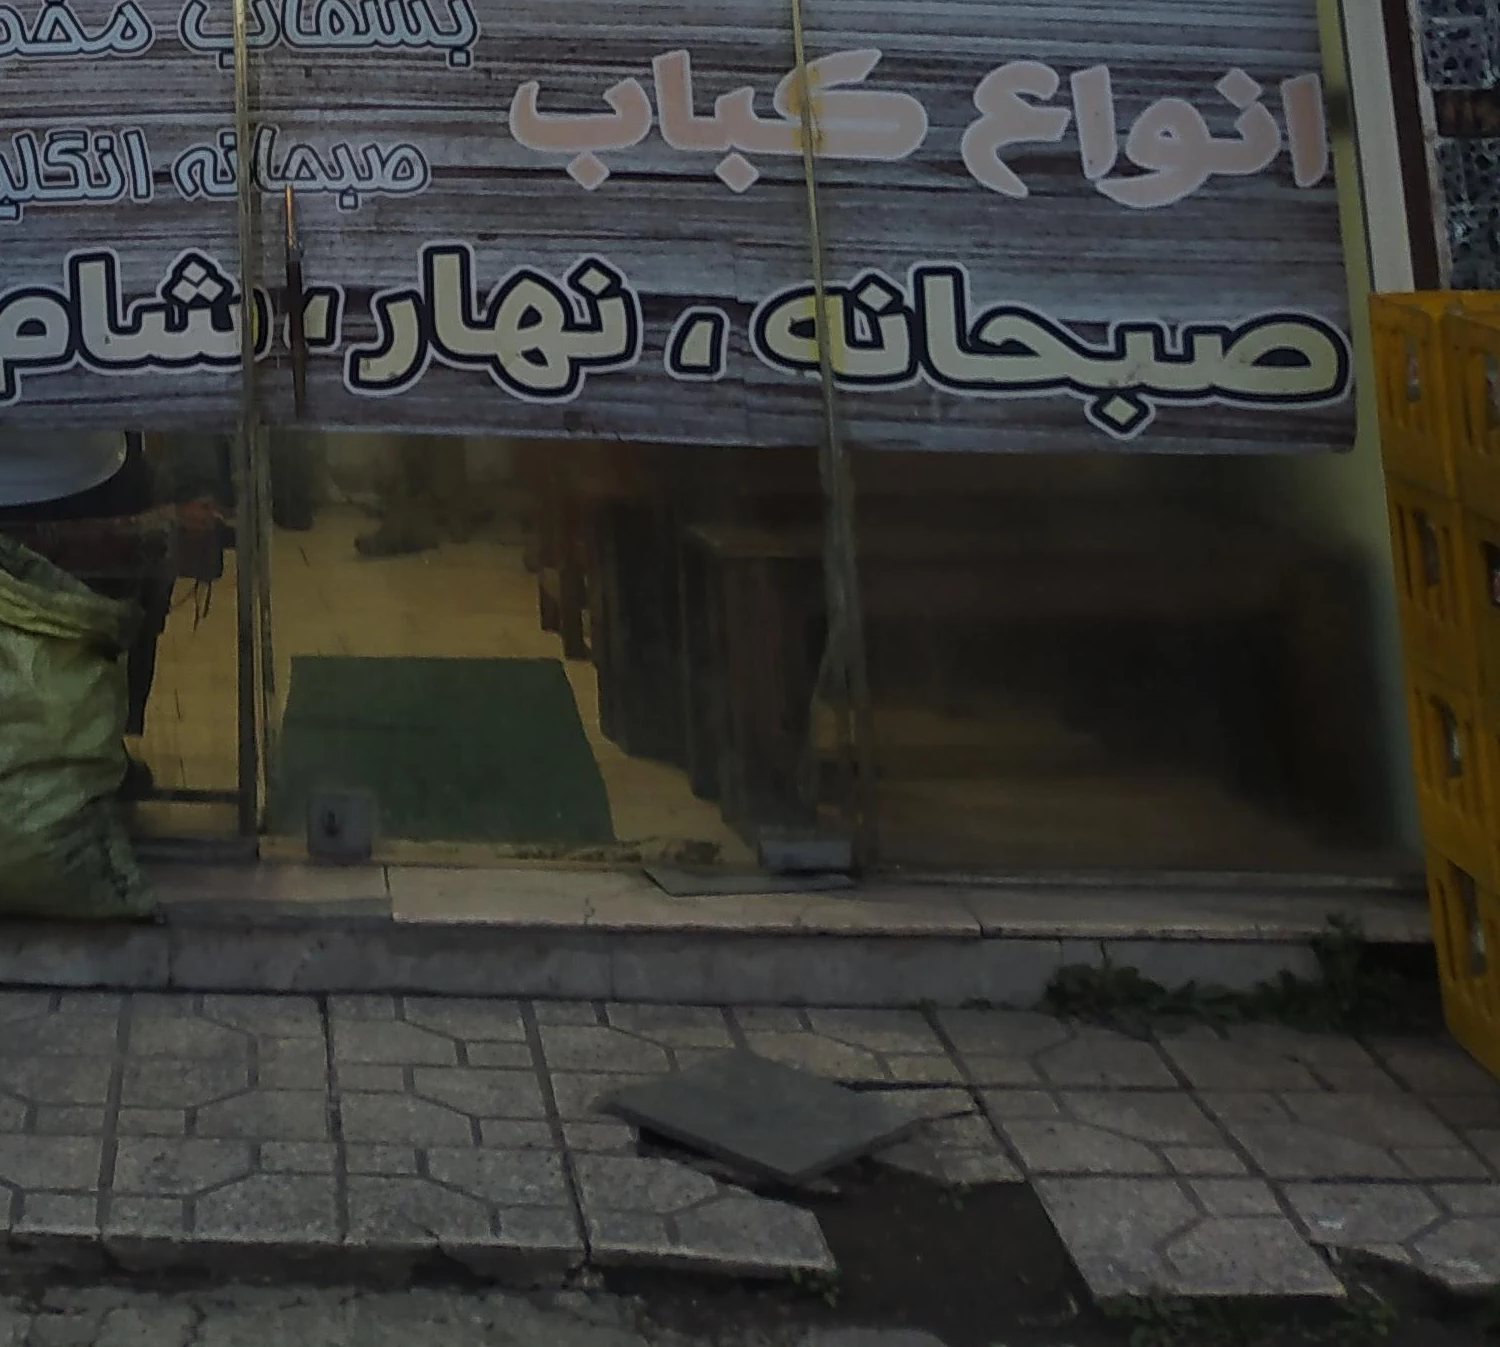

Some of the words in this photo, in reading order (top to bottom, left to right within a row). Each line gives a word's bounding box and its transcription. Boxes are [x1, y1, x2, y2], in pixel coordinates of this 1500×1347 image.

[171, 122, 432, 212] صبحانه
[508, 48, 930, 194] کباب
[961, 57, 1332, 209] انواع
[343, 238, 646, 405] نهار
[748, 260, 1354, 440] صبحانه
